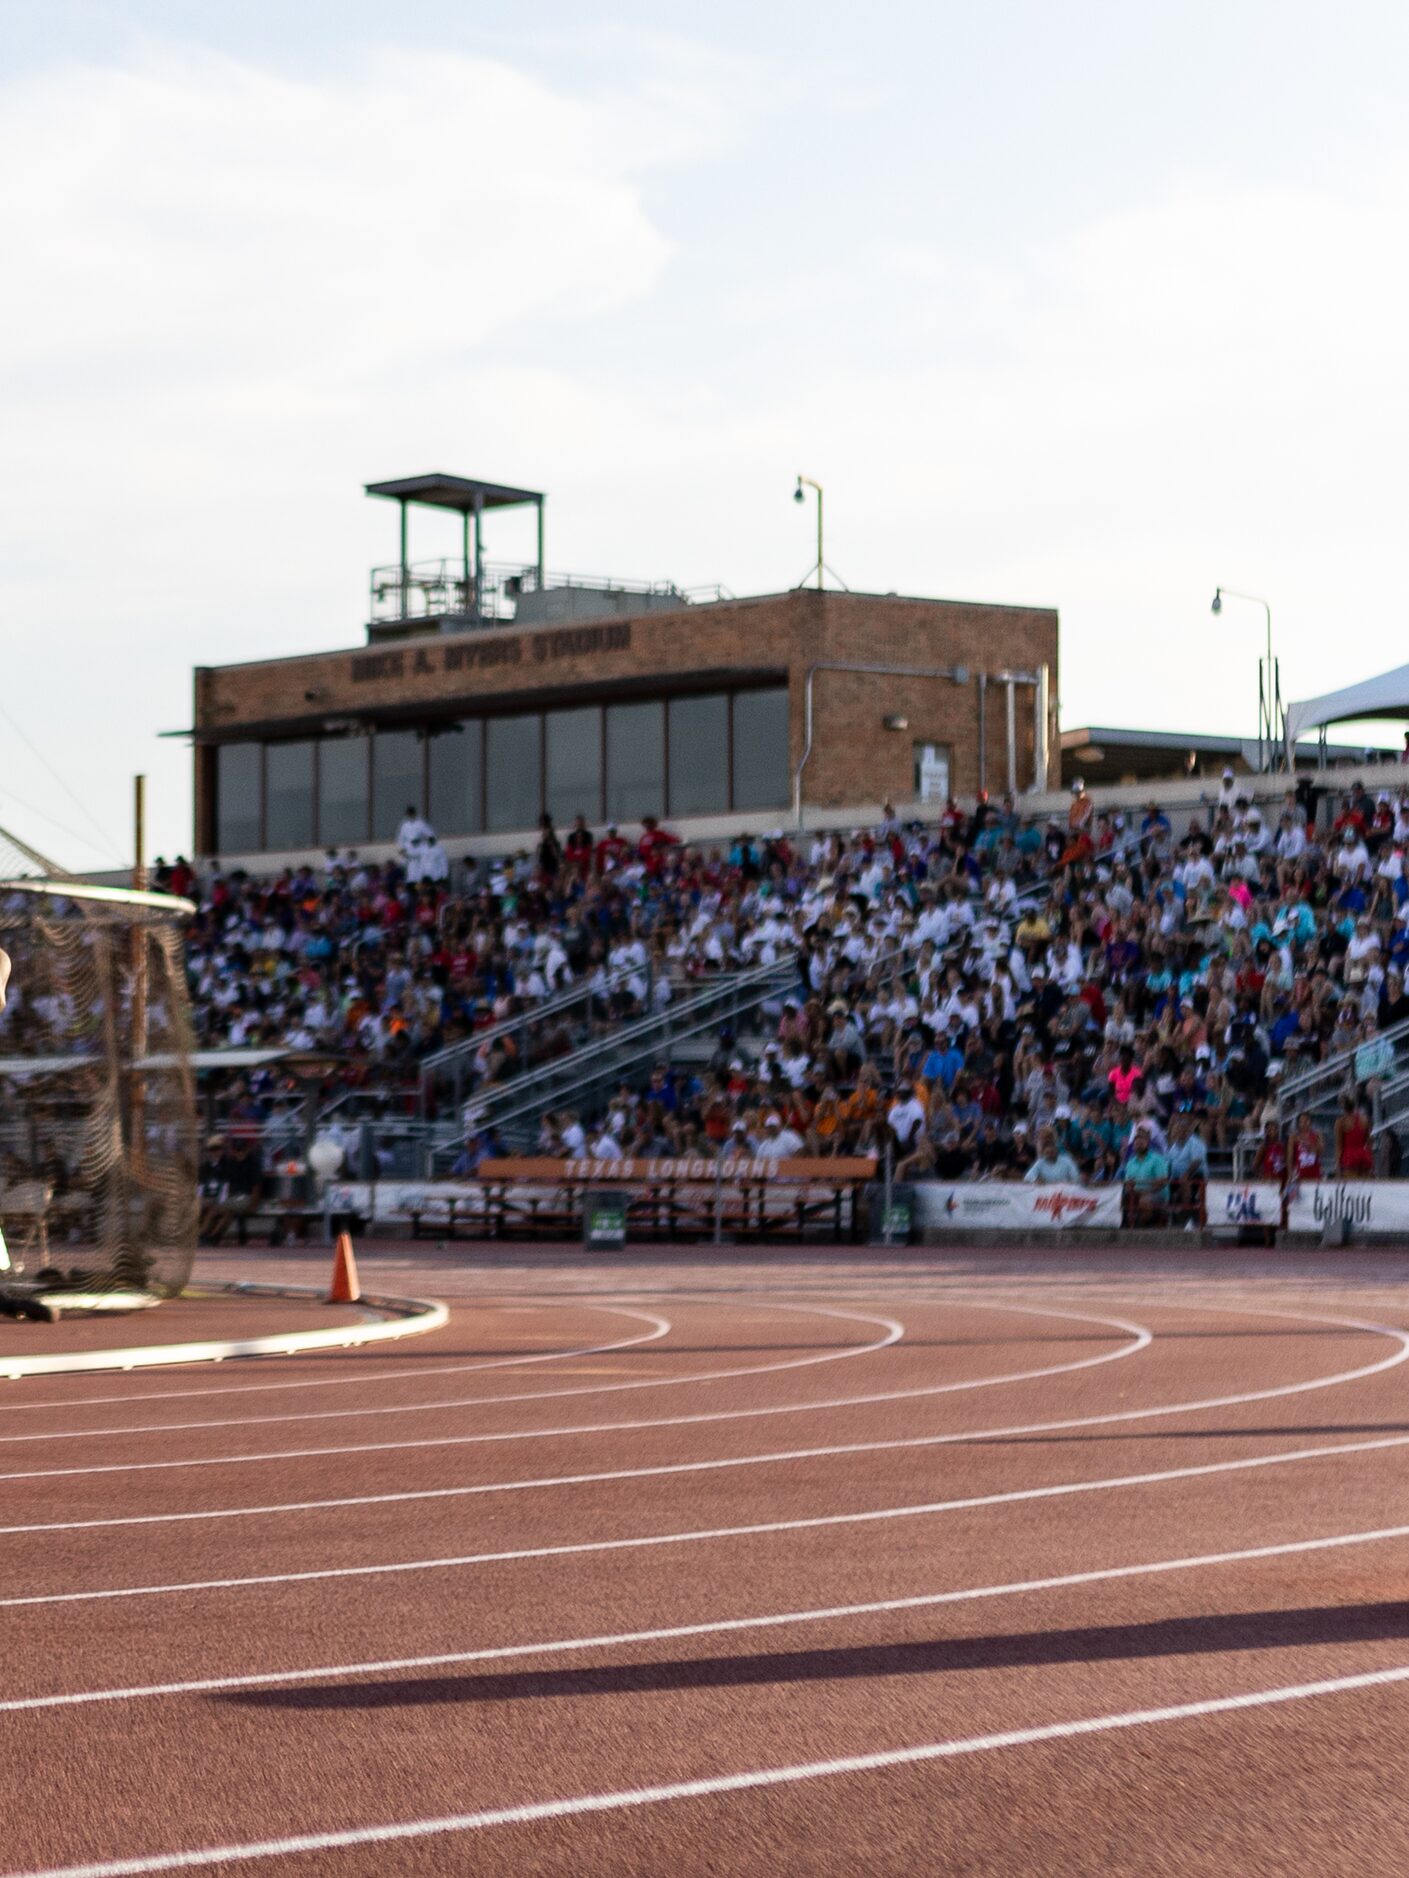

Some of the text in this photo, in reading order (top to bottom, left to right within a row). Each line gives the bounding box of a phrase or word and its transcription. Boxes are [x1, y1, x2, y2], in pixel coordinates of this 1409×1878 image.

[531, 622, 631, 663] STADIUM
[564, 1158, 780, 1178] TEXAS LONGHORNS
[1313, 1183, 1372, 1223] balfour
